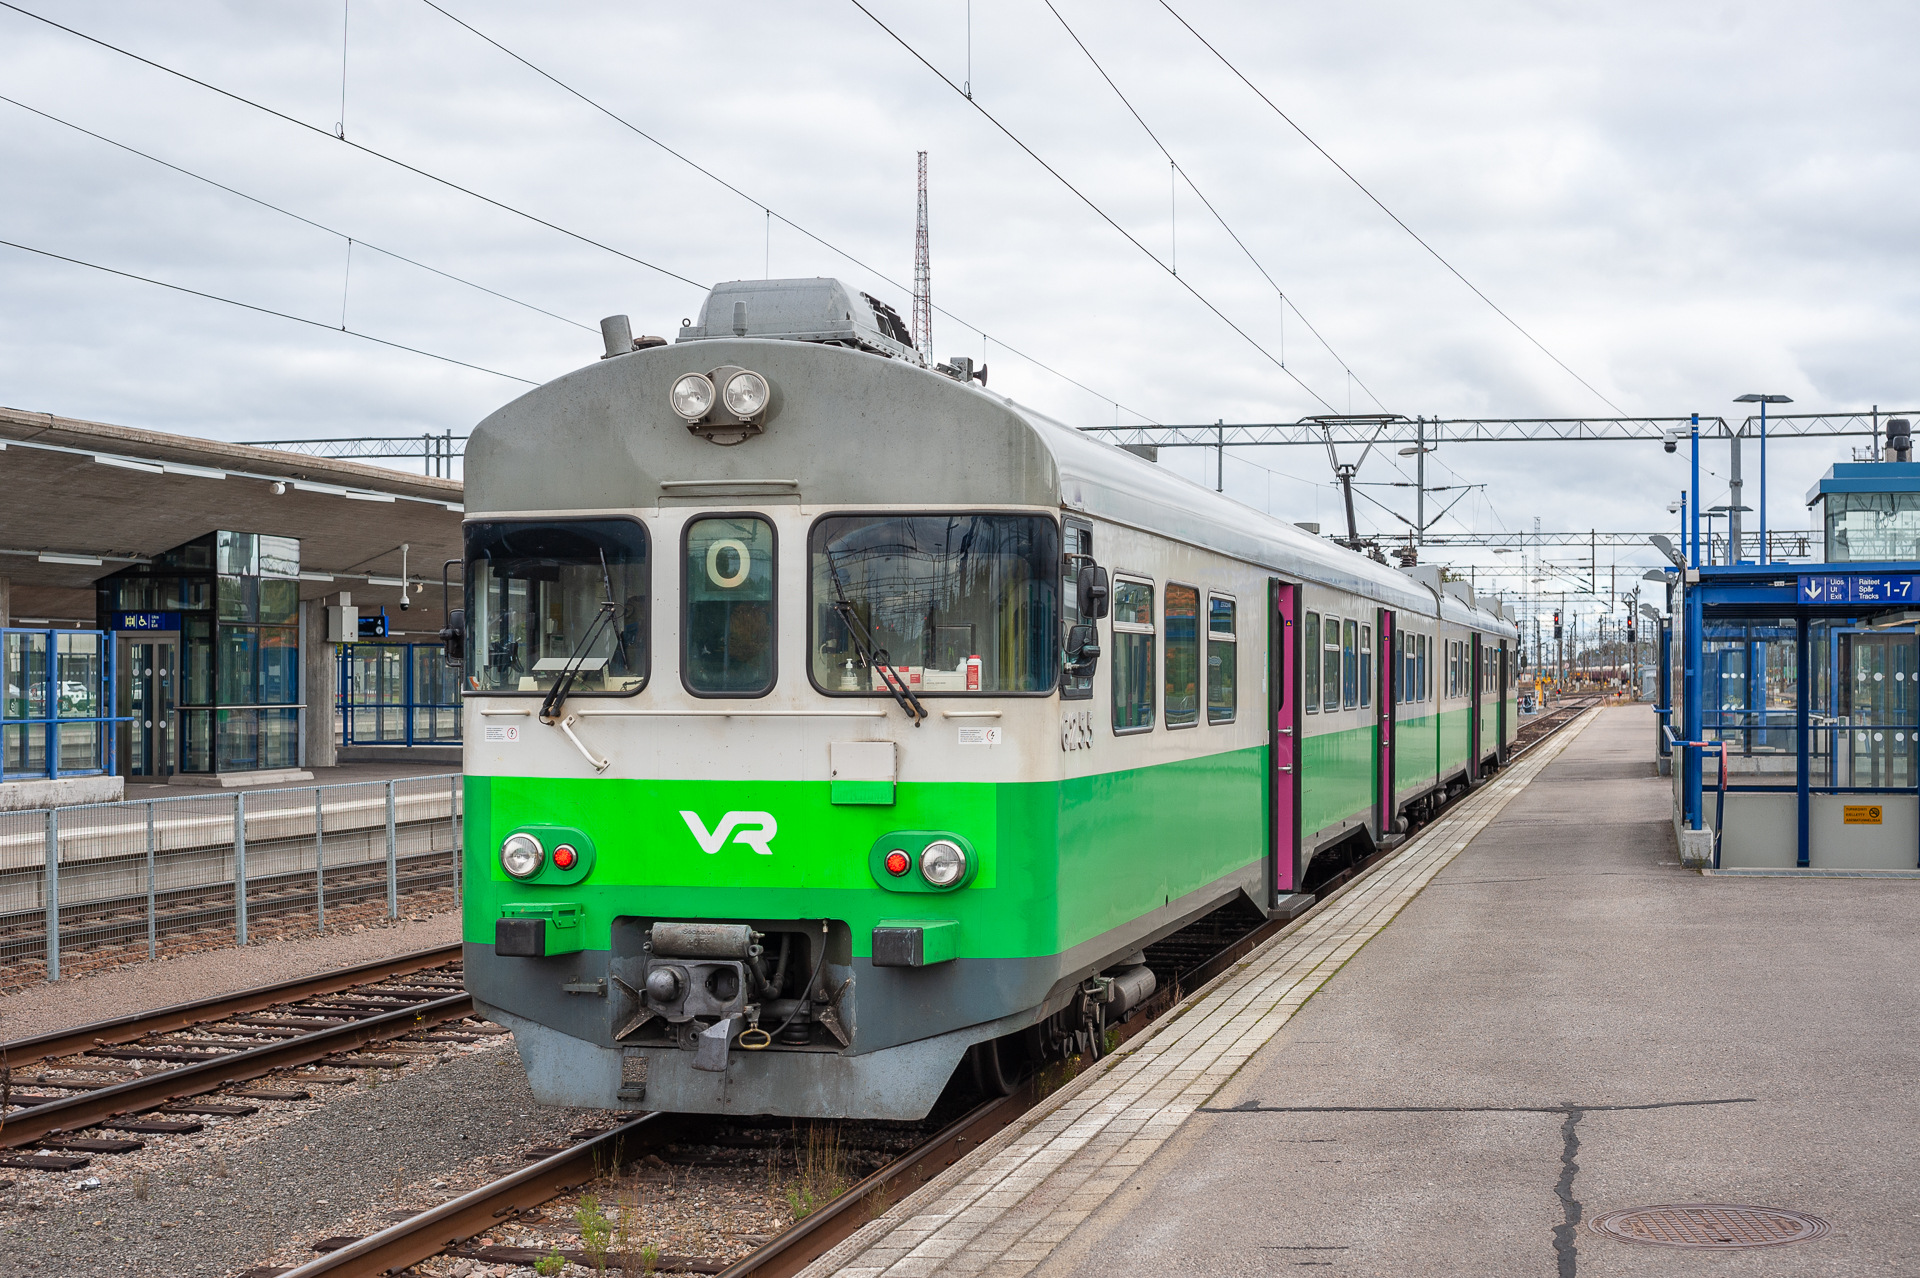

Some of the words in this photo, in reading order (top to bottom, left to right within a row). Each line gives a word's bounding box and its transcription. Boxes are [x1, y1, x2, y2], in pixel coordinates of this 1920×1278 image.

[1859, 585, 1873, 593] Spår
[1883, 581, 1911, 597] 1-7
[679, 810, 778, 855] VR
